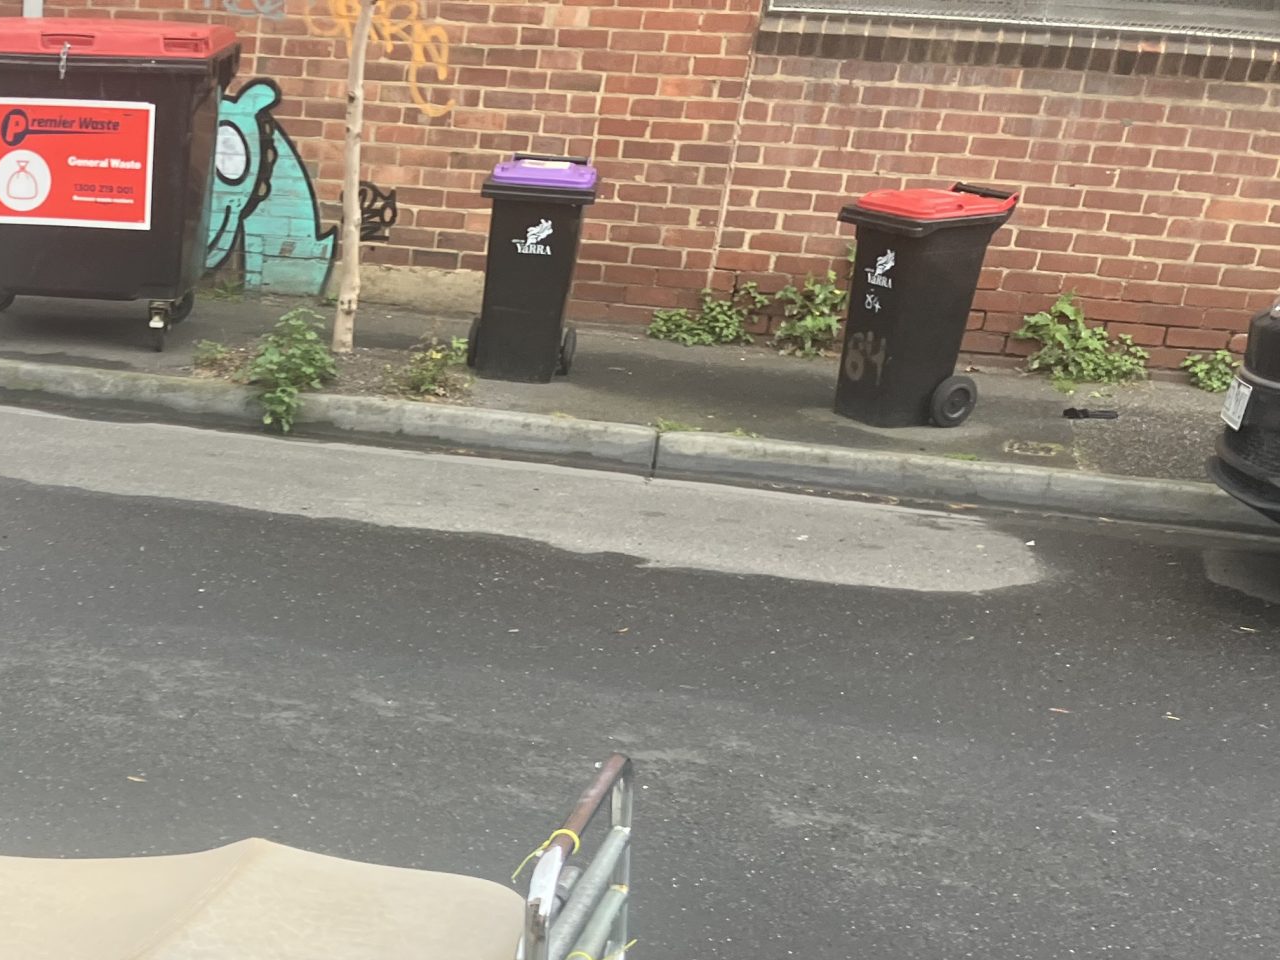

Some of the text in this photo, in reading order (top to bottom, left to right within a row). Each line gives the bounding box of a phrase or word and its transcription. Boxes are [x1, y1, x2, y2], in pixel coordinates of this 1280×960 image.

[1, 108, 120, 147] Premier Waste
[67, 156, 142, 170] General Waste
